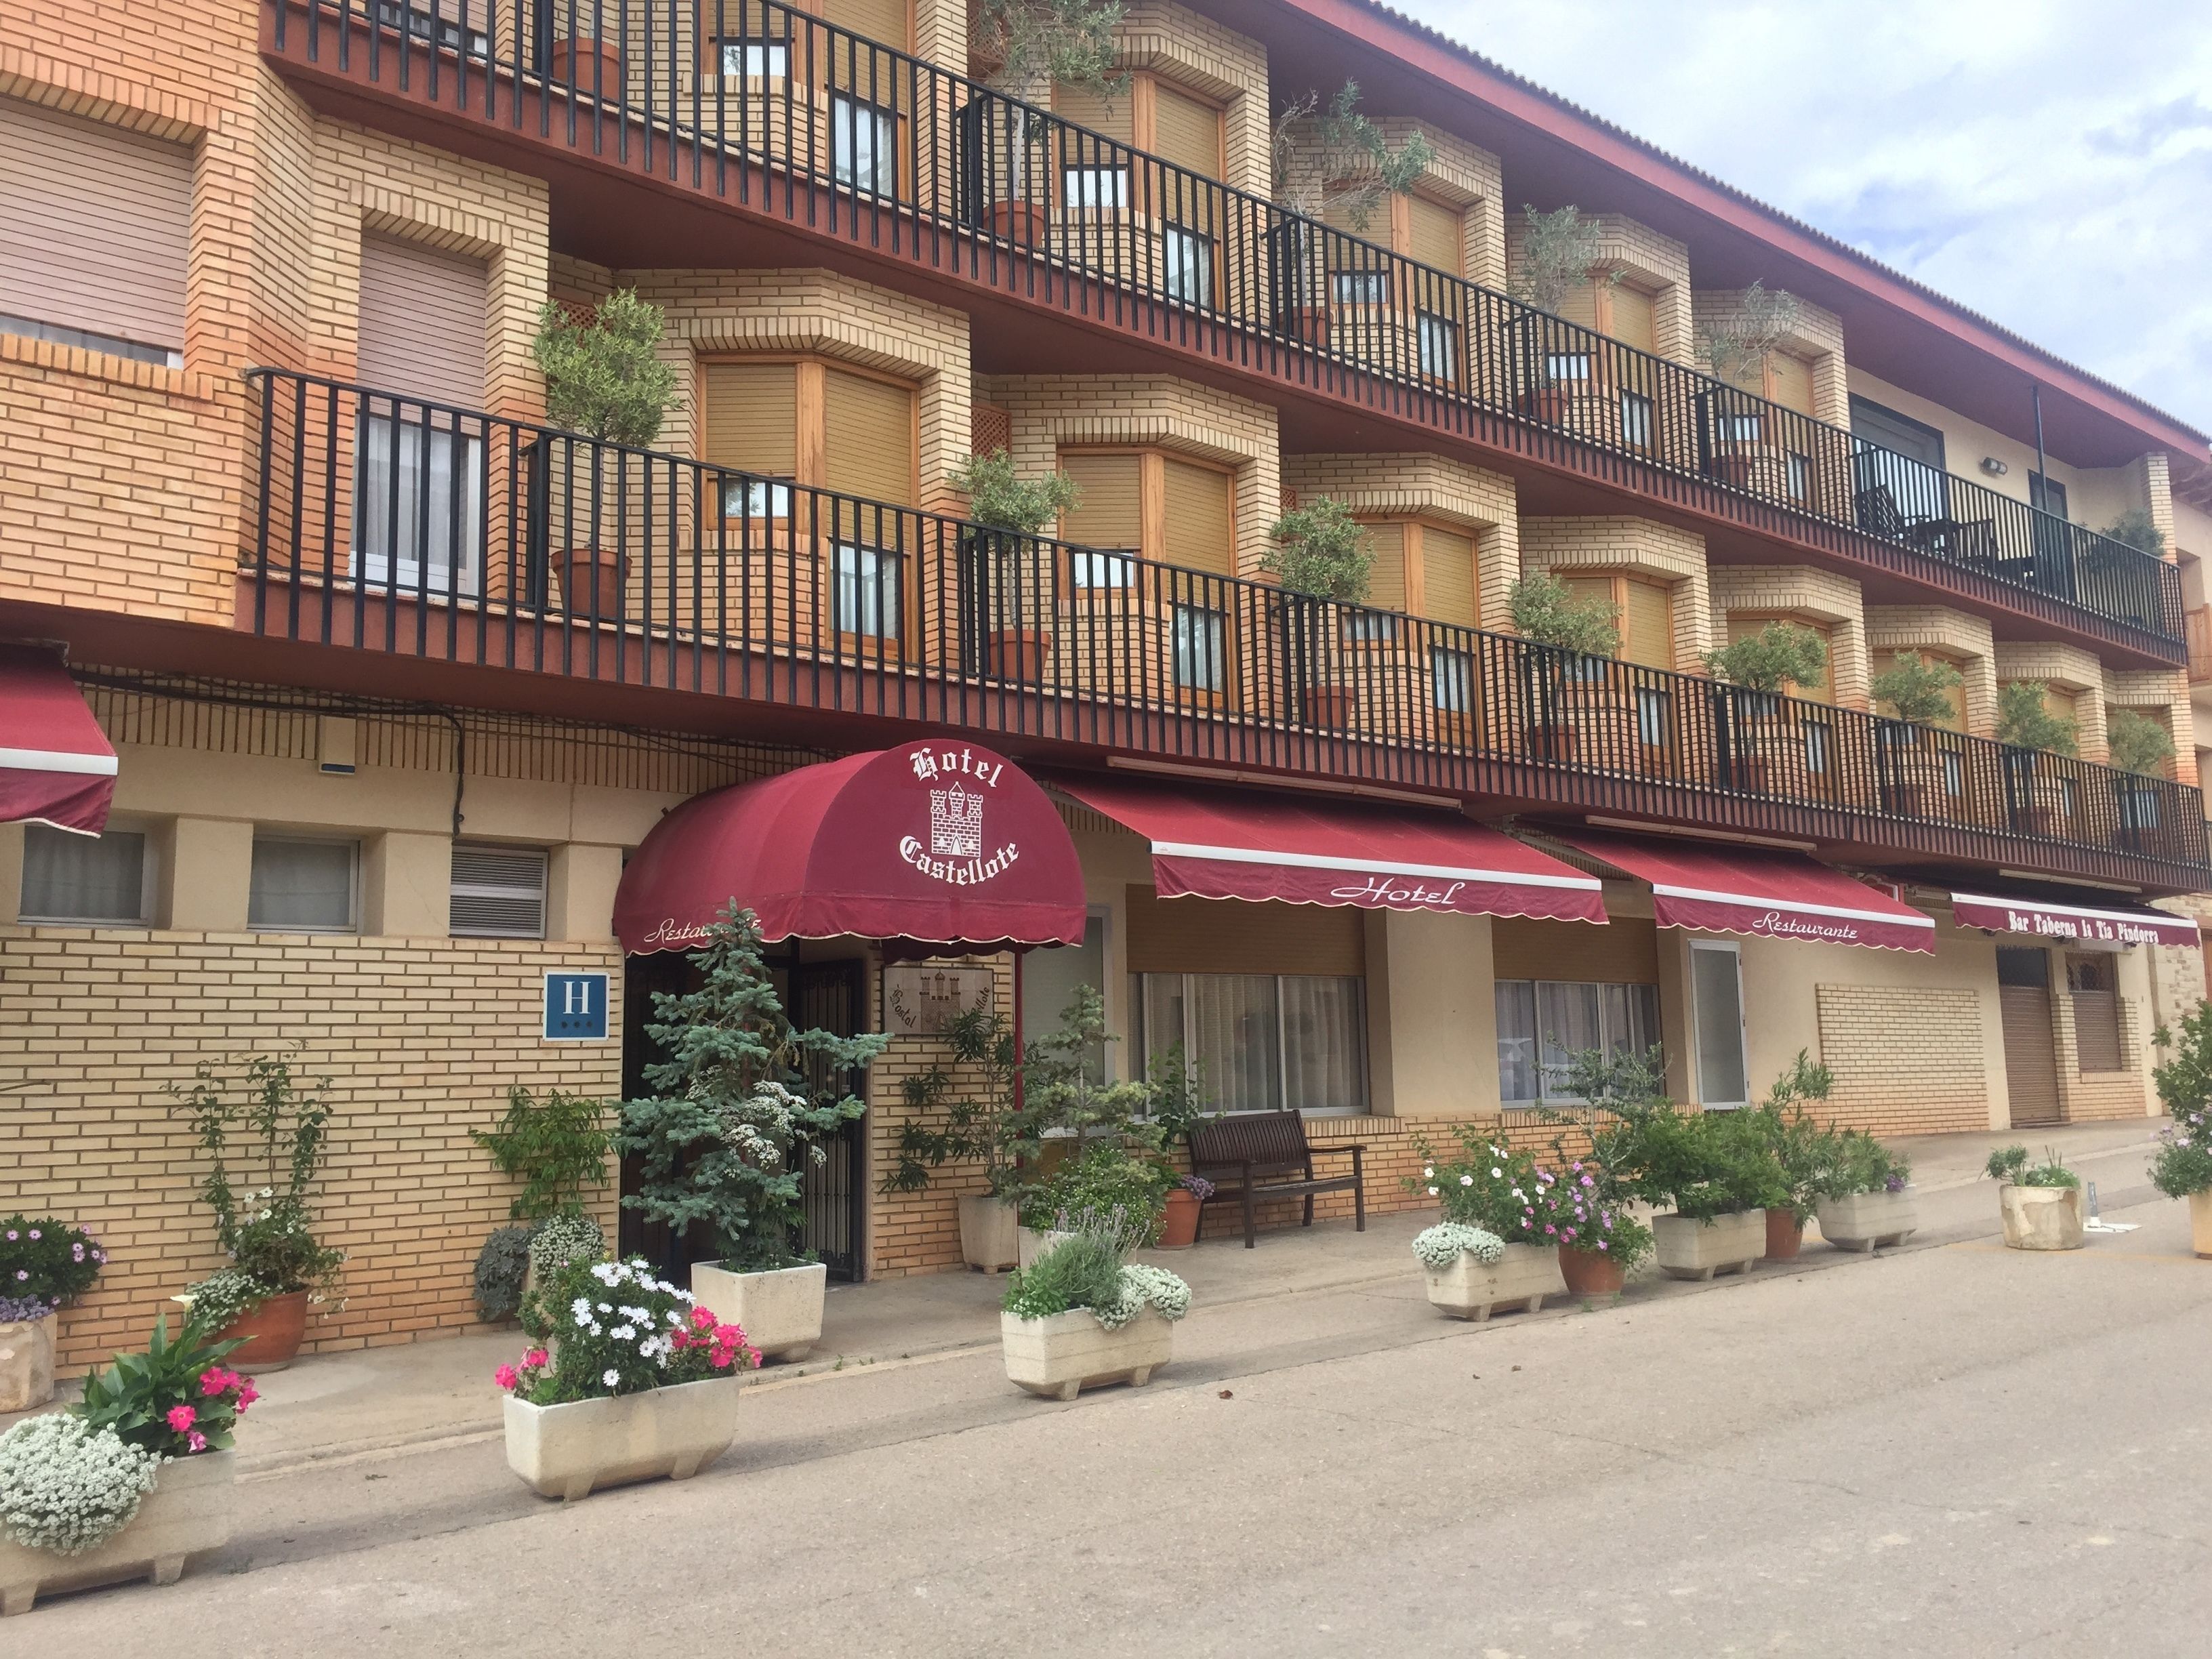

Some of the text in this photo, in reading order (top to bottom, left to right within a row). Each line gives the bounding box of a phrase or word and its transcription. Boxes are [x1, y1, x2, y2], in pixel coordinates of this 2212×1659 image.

[909, 747, 1004, 787] Hotel
[899, 836, 1019, 886] Castellote
[1330, 877, 1466, 905] Hotel
[644, 918, 762, 943] Restaue
[1752, 912, 1858, 939] Restaurante
[2008, 911, 2029, 932] Bar
[2034, 914, 2077, 937] Taberna
[2117, 923, 2159, 943] Pindorra
[562, 981, 591, 1014] H
[890, 984, 917, 1028] Hostal
